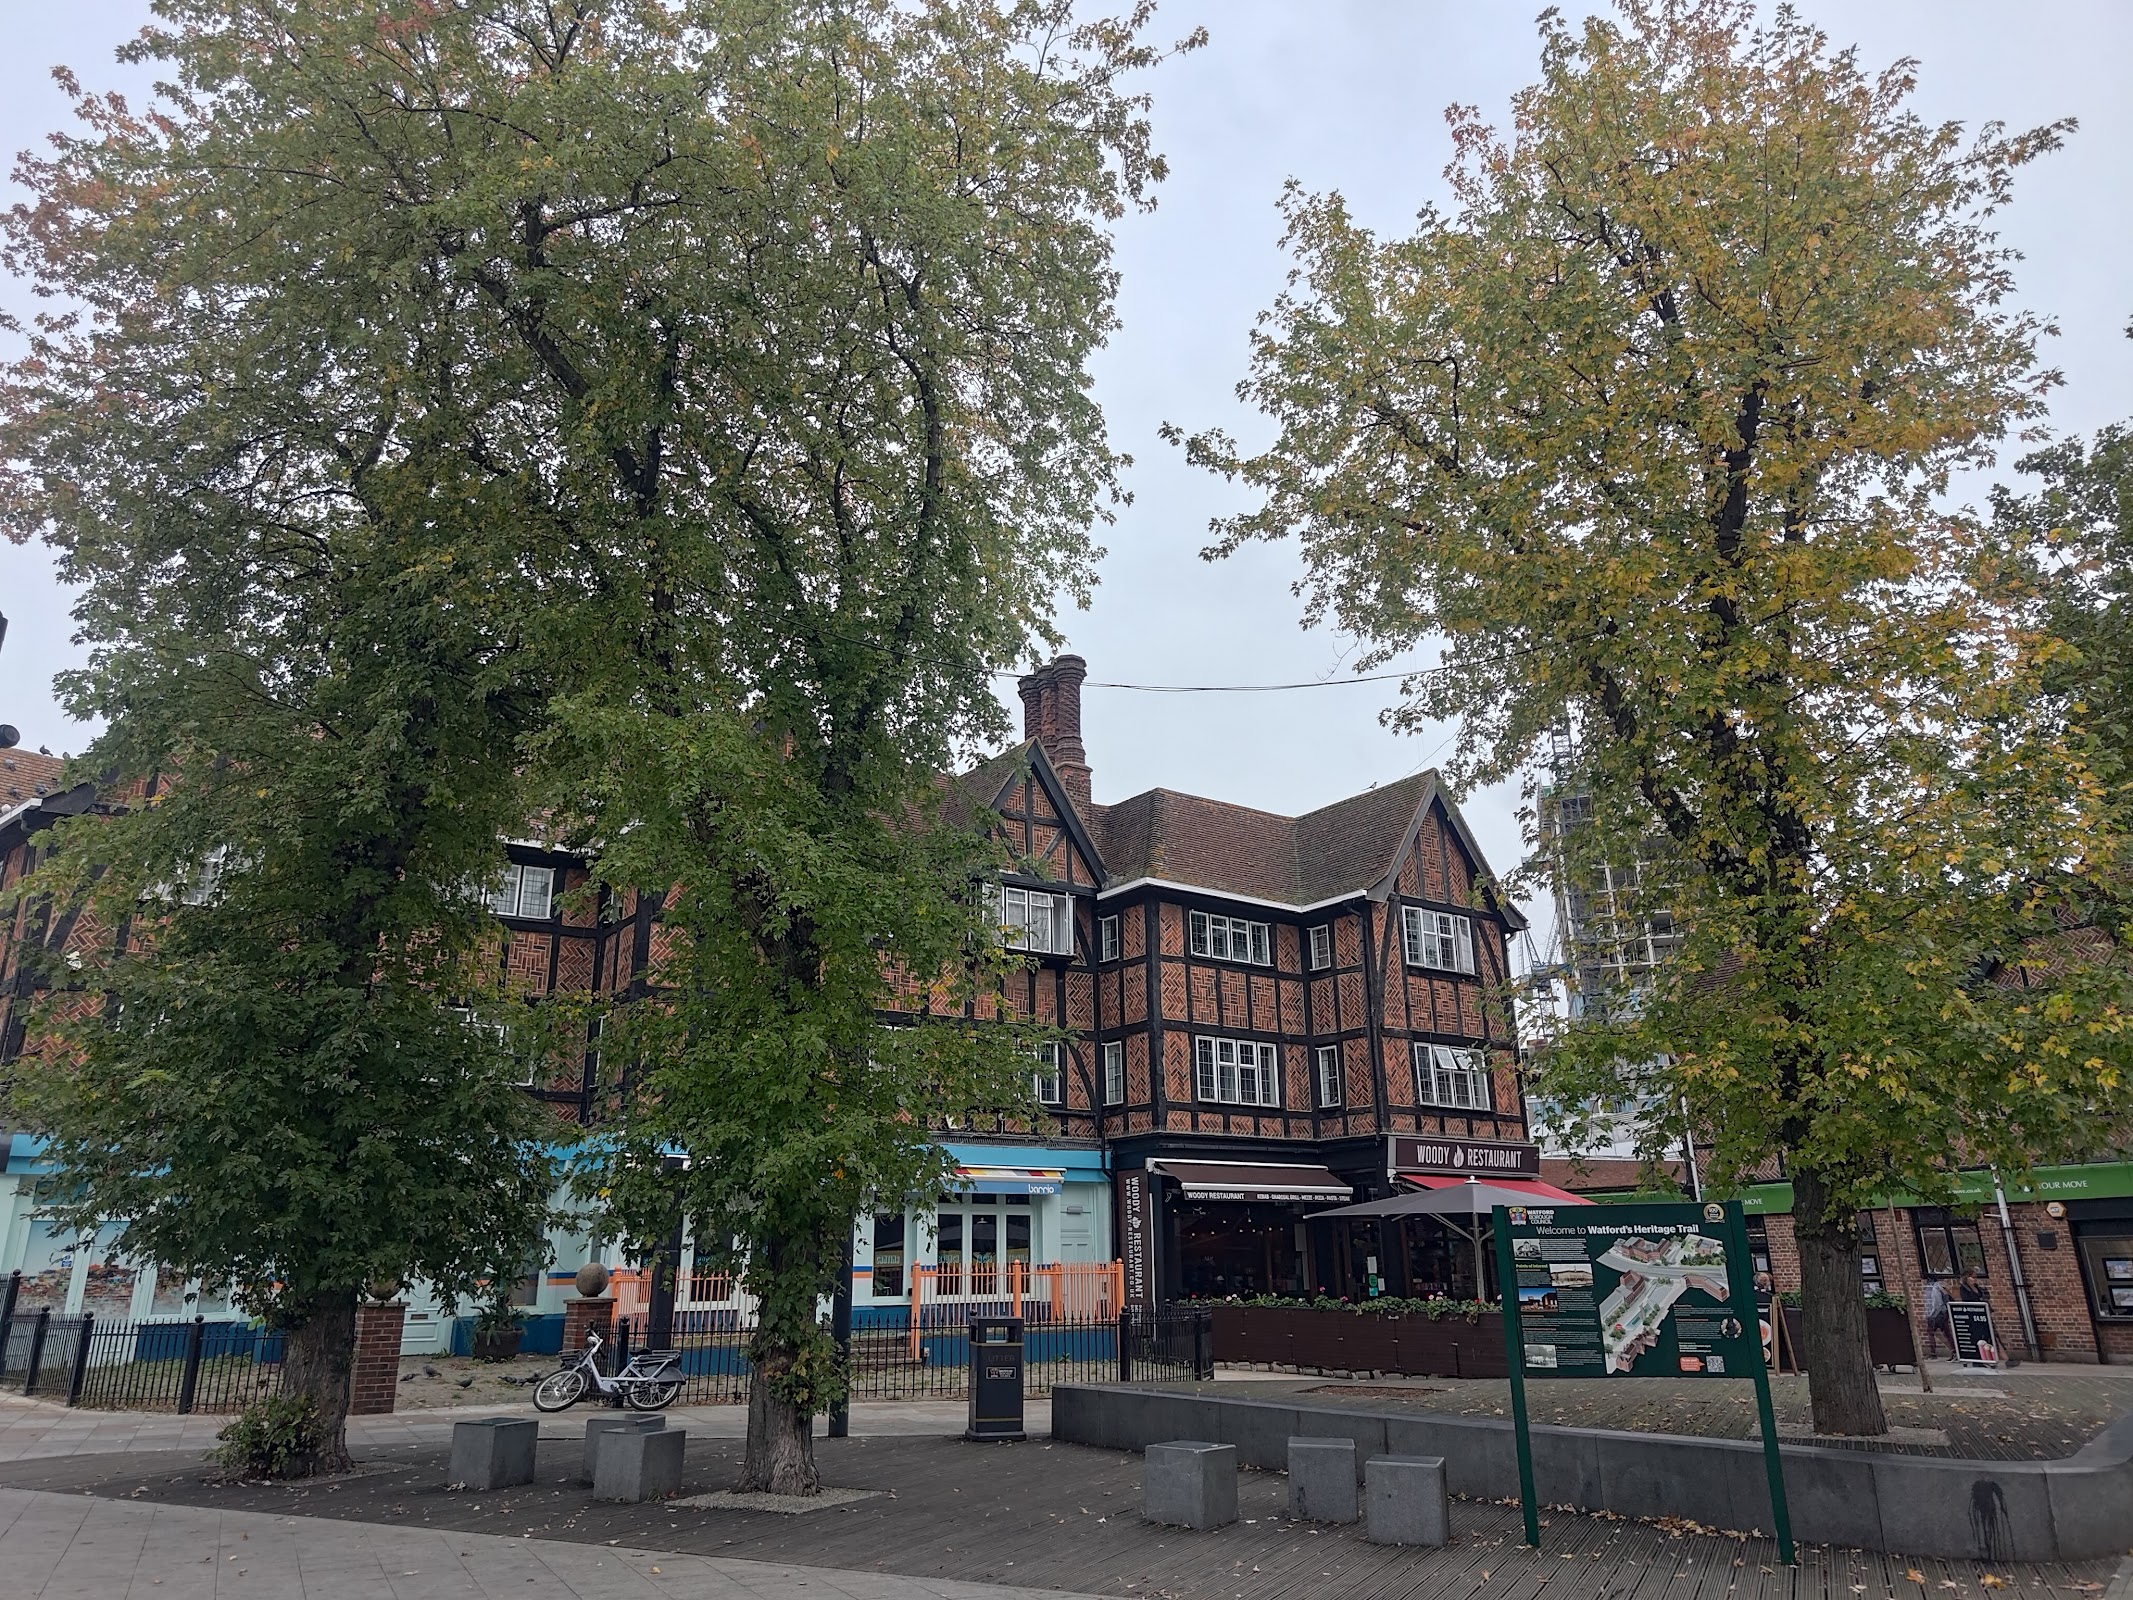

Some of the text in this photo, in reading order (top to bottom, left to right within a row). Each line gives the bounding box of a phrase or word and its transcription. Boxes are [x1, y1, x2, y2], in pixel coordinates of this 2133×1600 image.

[1417, 1144, 1522, 1168] WOODY RESTAURANT
[1028, 1183, 1055, 1194] barrio
[2062, 1180, 2089, 1189] MOVE
[1131, 1176, 1141, 1213] WOODY
[1187, 1191, 1245, 1200] WOODY RESTAURANT
[1744, 1198, 1764, 1206] MOVE
[1536, 1224, 1700, 1236] Welcome to Watford's Heritage Trail
[1133, 1232, 1144, 1298] RESTAURANT
